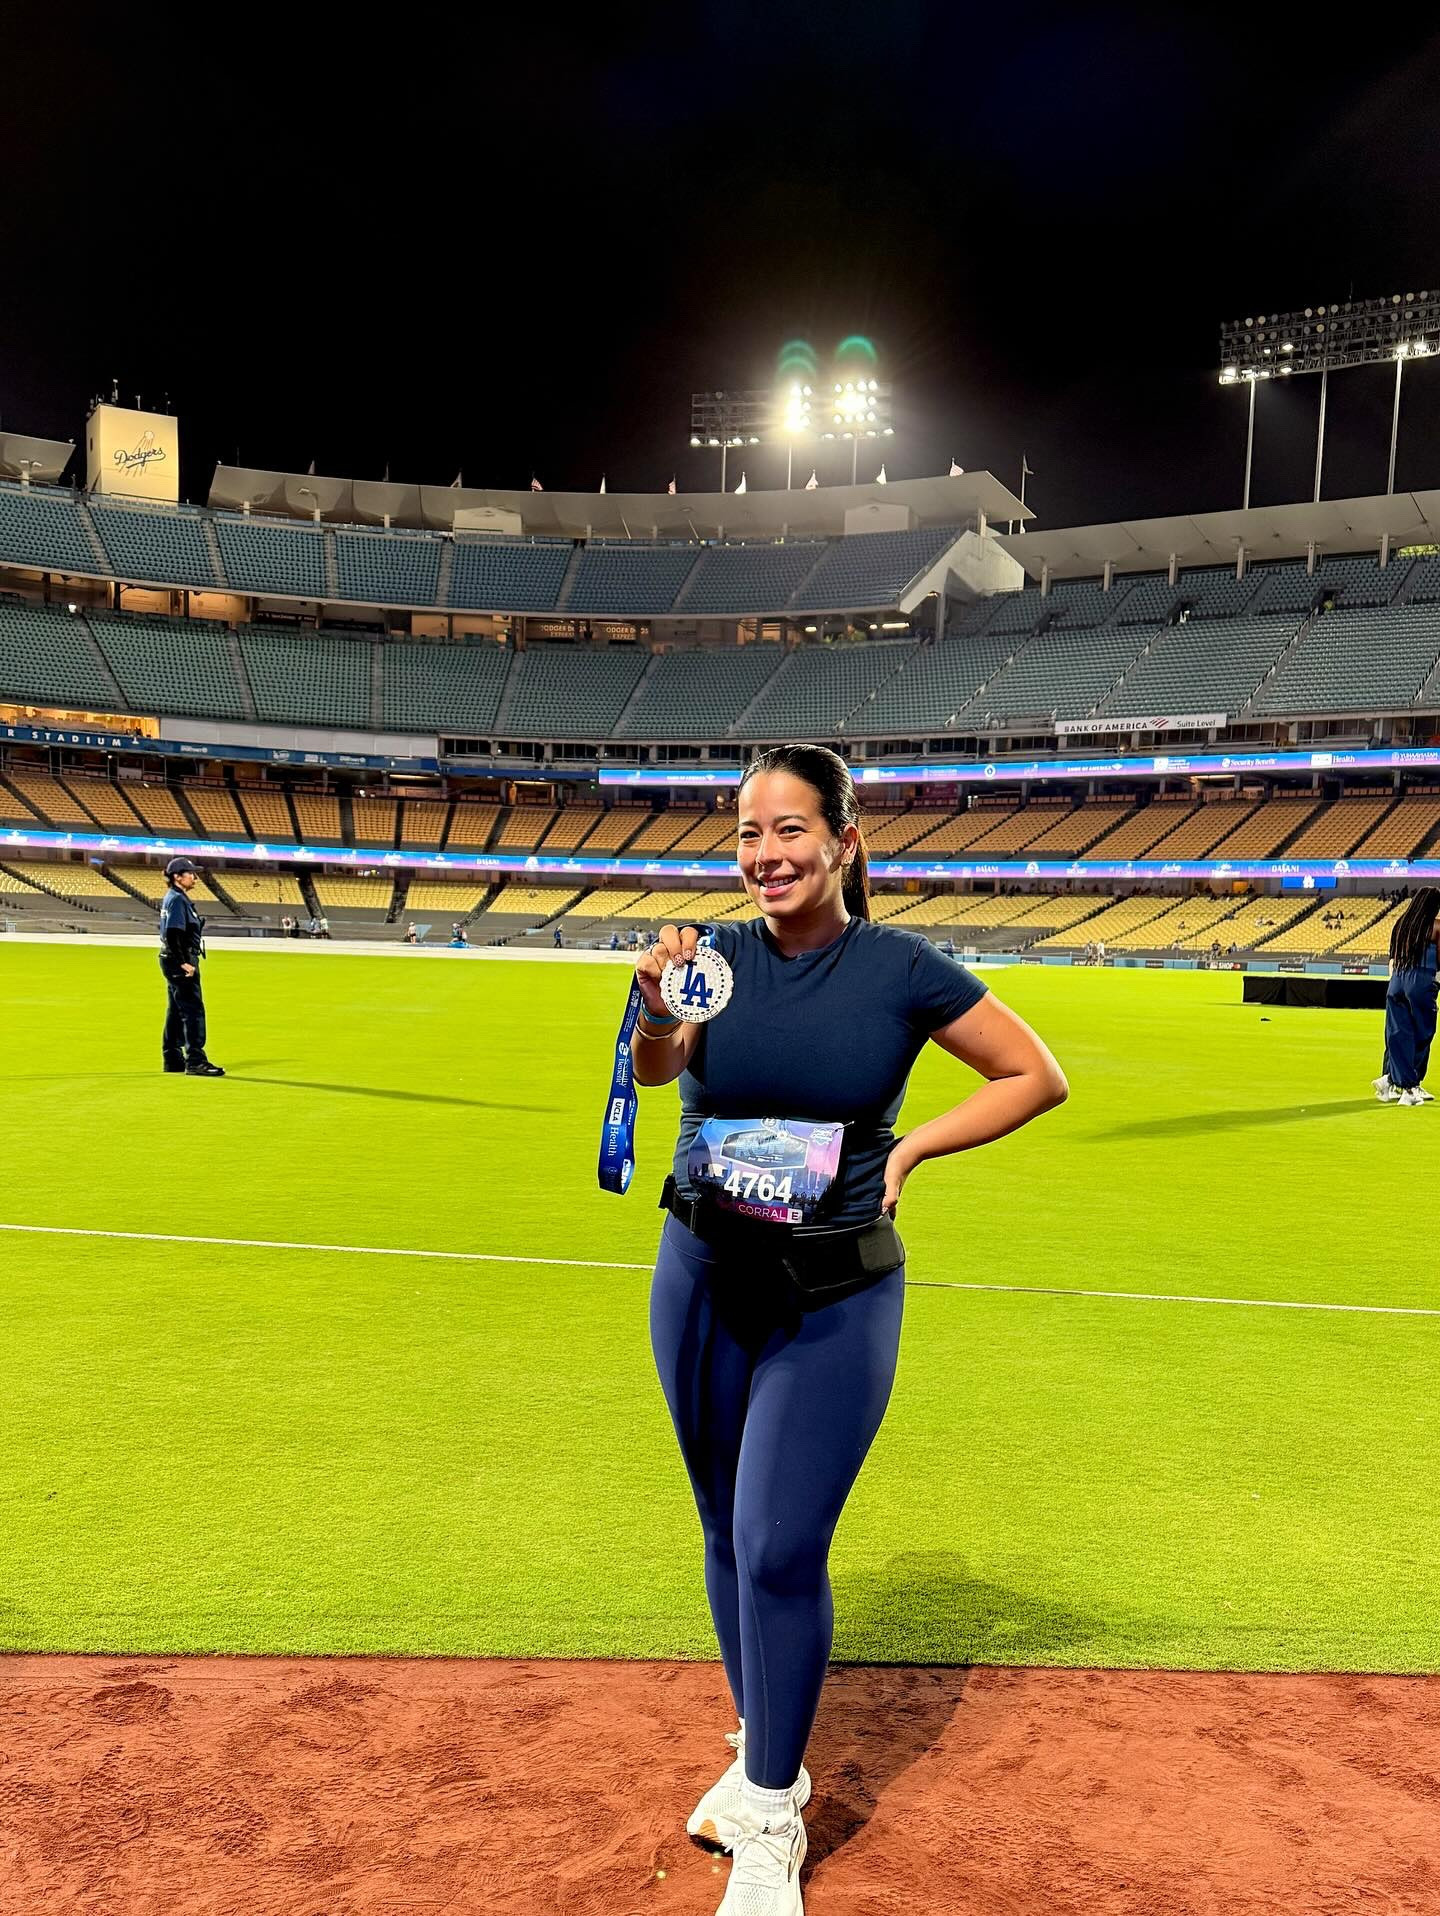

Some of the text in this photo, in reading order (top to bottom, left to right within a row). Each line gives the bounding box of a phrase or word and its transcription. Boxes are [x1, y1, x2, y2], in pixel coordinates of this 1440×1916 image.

[114, 447, 166, 468] Dodgers
[1064, 725, 1089, 733] BANK
[1105, 722, 1148, 731] AMERICA
[1177, 719, 1216, 728] Suite Level
[32, 731, 121, 747] STADIUM
[1271, 864, 1300, 872] DASANI
[680, 961, 714, 1008] LA
[612, 1101, 622, 1122] UCLA
[608, 1126, 619, 1156] Health
[724, 1170, 793, 1204] 4764
[738, 1204, 800, 1220] CORRAL E
